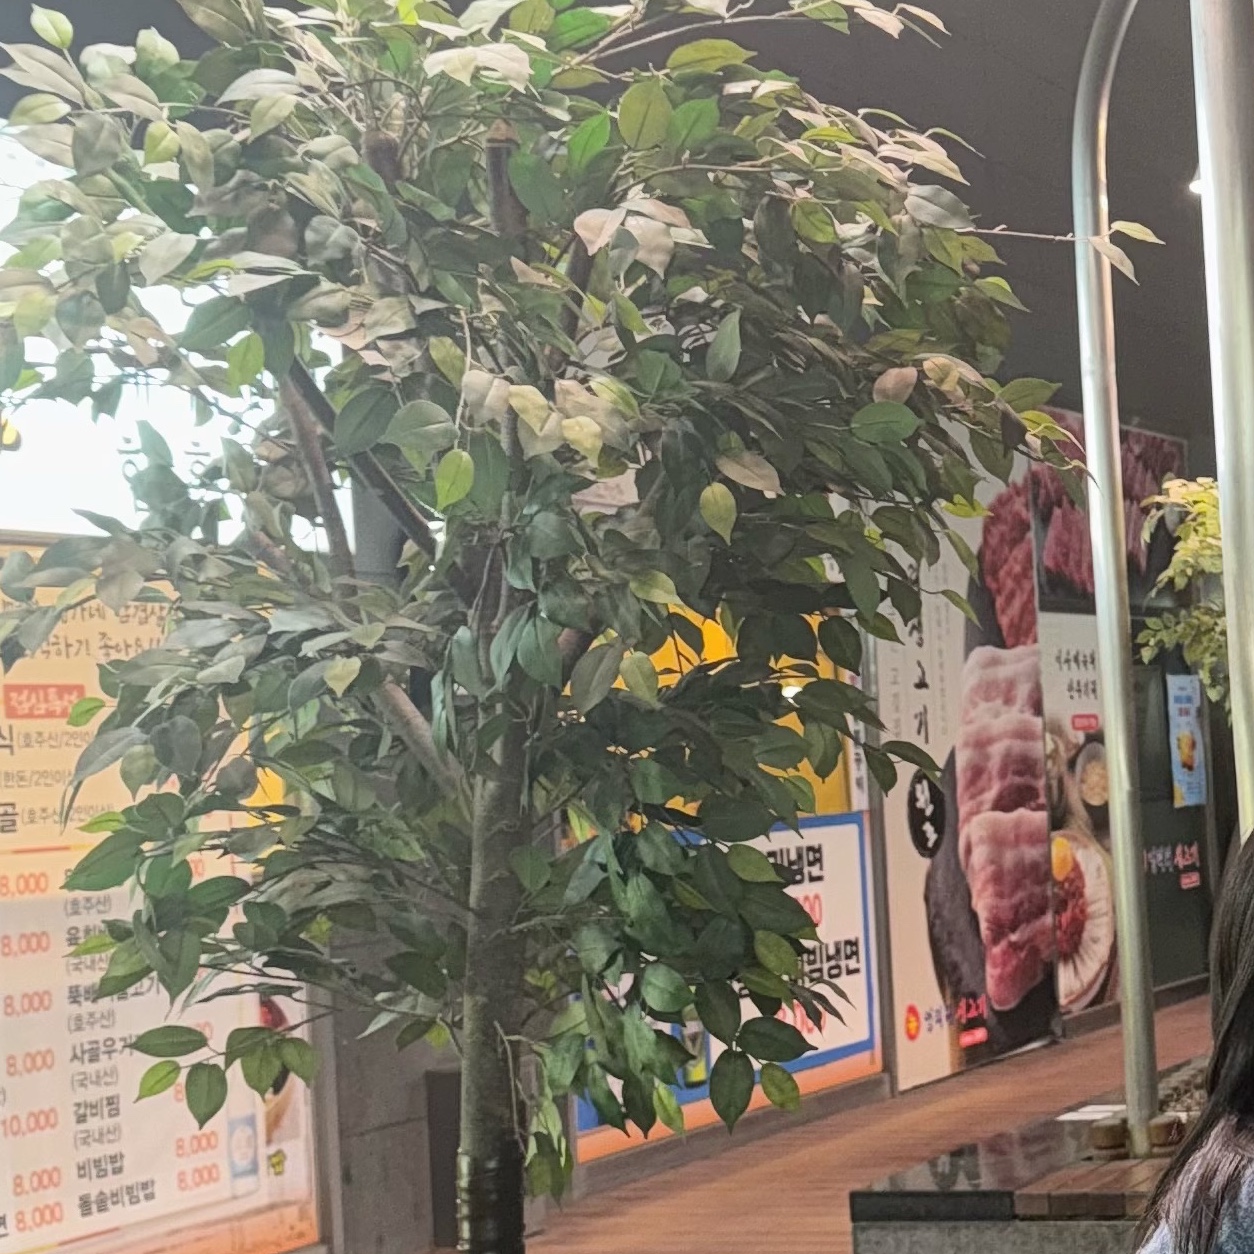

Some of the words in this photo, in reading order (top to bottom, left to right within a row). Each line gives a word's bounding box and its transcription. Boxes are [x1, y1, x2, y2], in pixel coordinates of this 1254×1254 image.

[1, 931, 51, 957] 8,000
[4, 990, 53, 1017] 8,000
[6, 1050, 55, 1077] 8,000
[76, 1151, 125, 1181] 비빔밥
